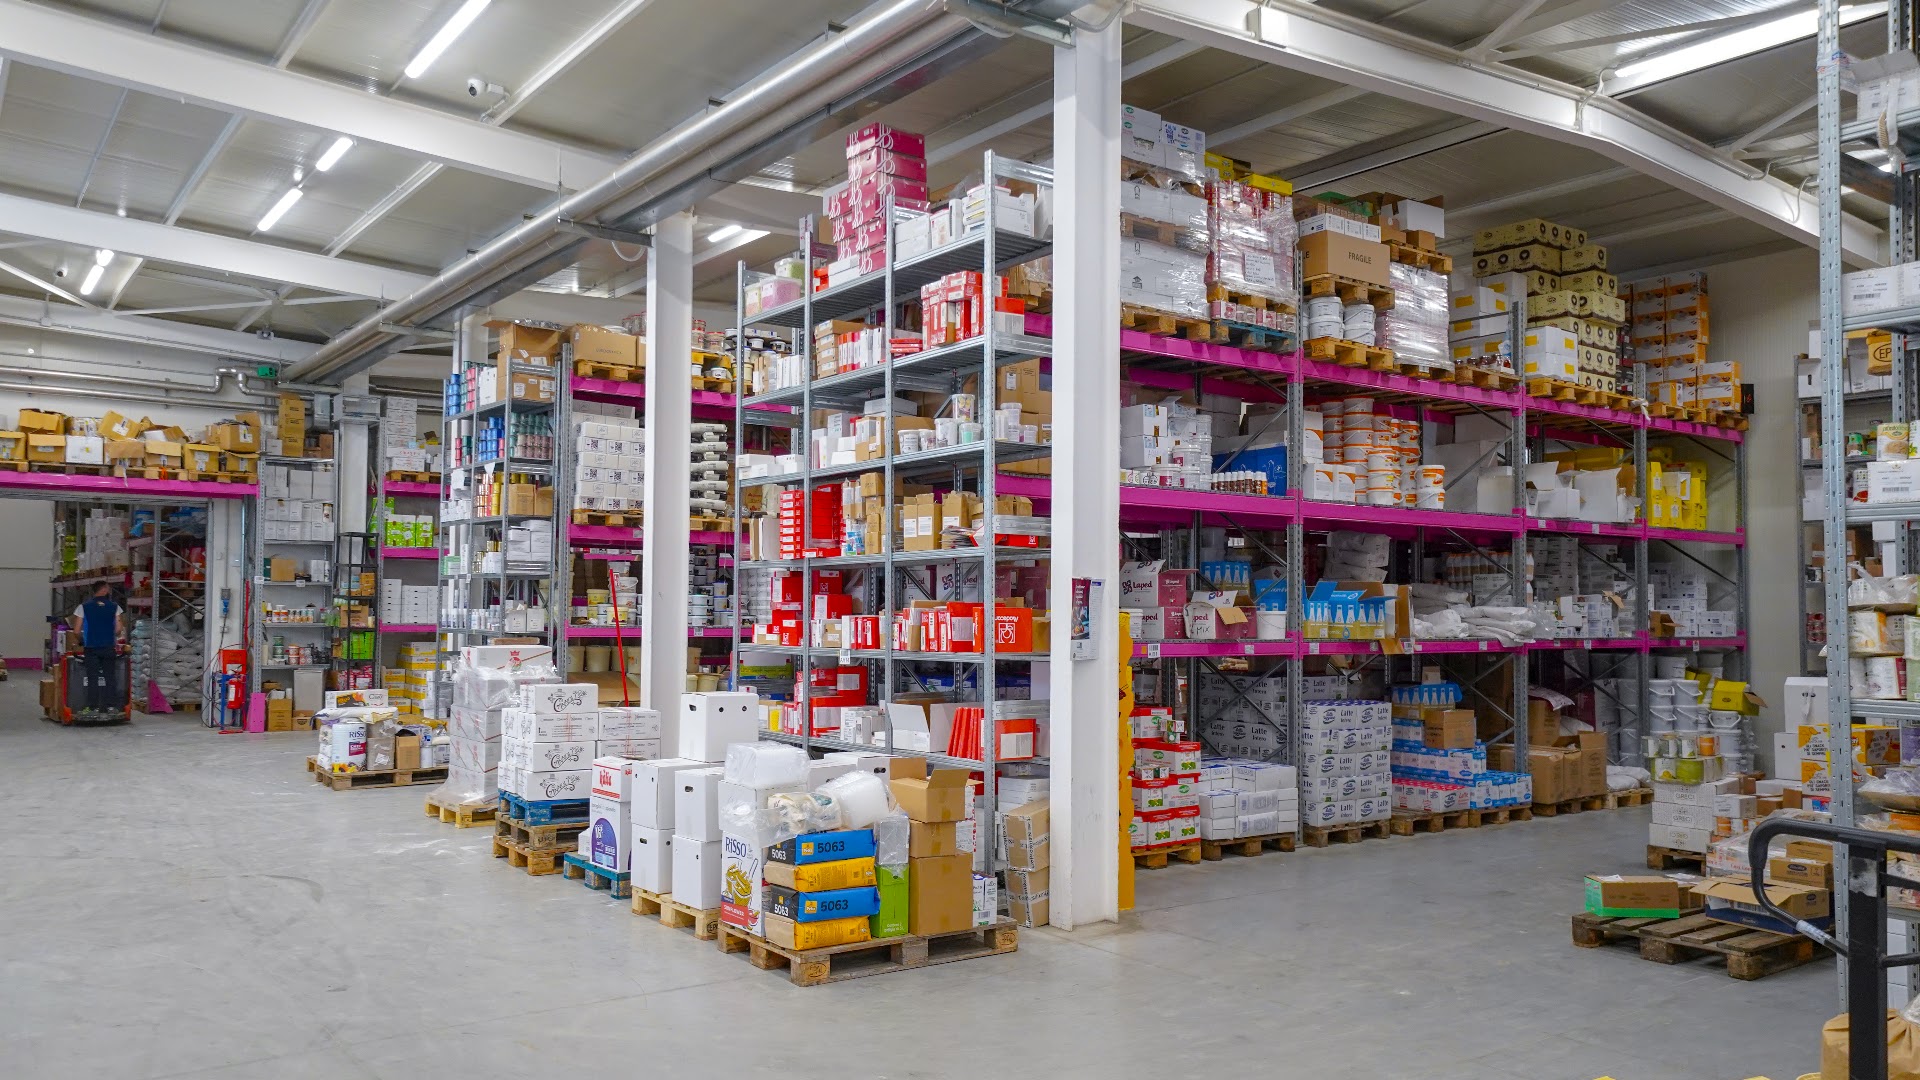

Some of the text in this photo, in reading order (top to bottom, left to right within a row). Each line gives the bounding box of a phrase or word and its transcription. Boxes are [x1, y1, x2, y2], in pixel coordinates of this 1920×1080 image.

[1348, 251, 1372, 265] FRAGILE
[1879, 348, 1892, 359] EP
[1132, 581, 1153, 589] Laped
[1142, 613, 1158, 621] aped
[817, 840, 845, 853] 5063
[771, 848, 787, 860] 5063
[774, 903, 789, 917] 5063
[820, 899, 849, 912] 5063
